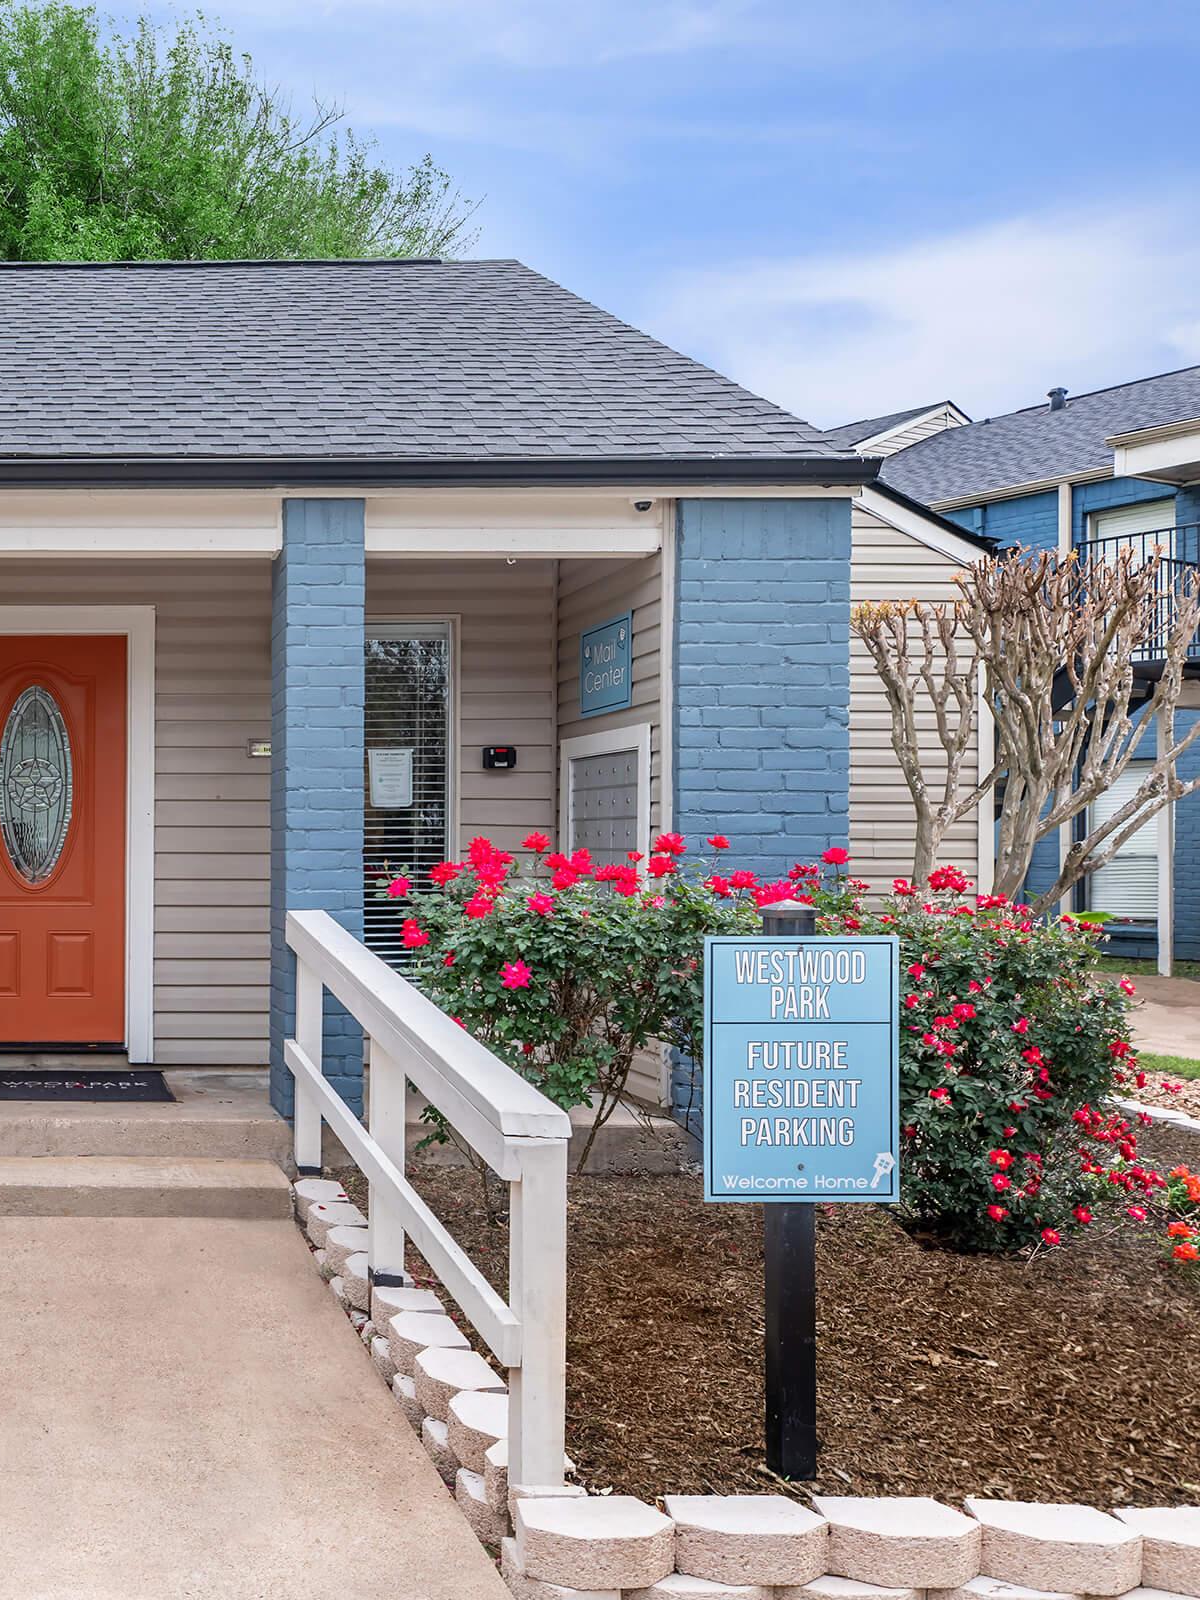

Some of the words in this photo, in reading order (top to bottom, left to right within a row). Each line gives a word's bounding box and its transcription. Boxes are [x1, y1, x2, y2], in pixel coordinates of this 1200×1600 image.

[593, 640, 616, 665] Mail
[584, 666, 625, 693] Center
[734, 950, 866, 985] WESTWOOD
[770, 985, 831, 1019] PARK
[747, 1041, 849, 1070] FUTURE
[733, 1079, 862, 1108] RESIDENT
[740, 1117, 855, 1147] PARKING
[722, 1174, 809, 1189] Welcome
[815, 1174, 869, 1189] Home
